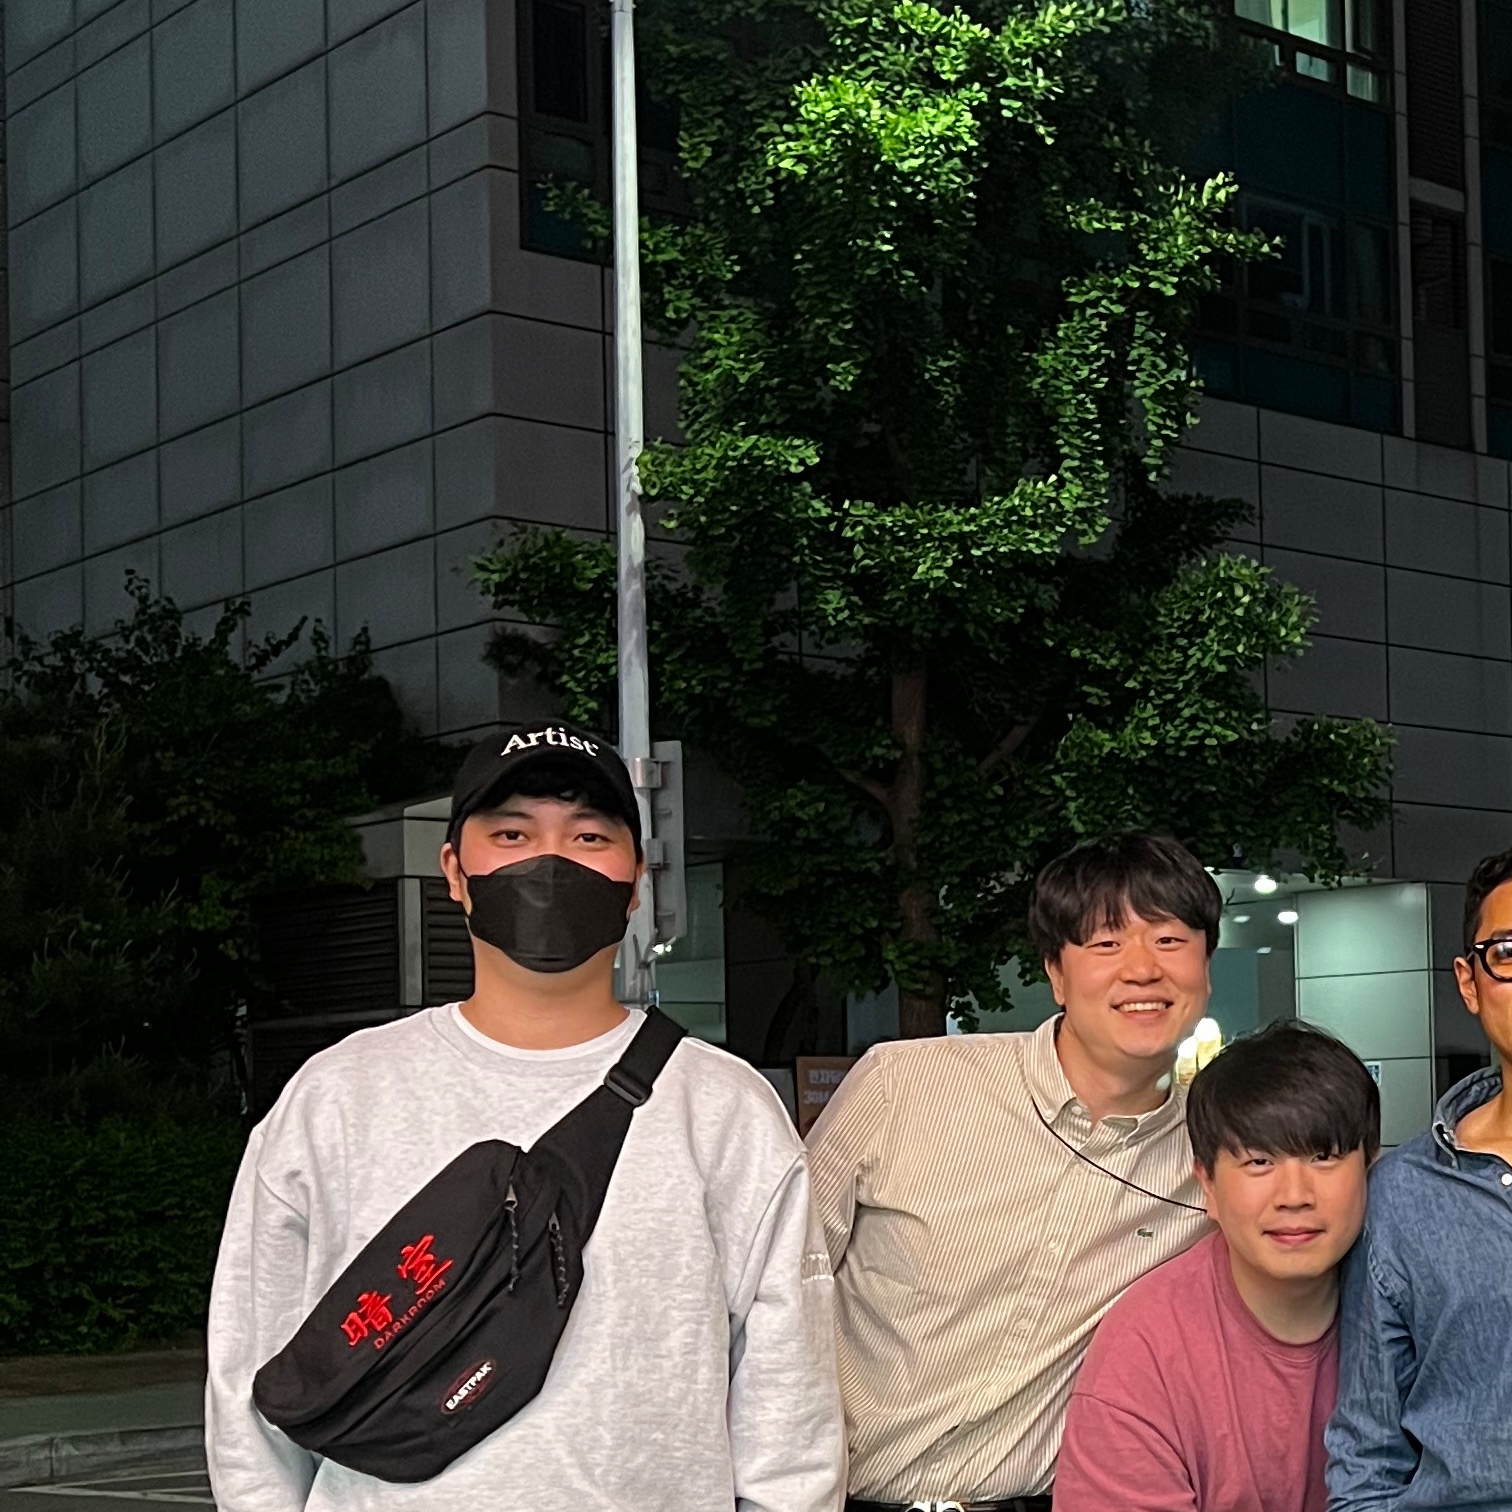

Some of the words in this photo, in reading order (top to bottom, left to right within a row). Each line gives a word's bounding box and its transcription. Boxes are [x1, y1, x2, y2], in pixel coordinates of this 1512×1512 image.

[500, 727, 599, 757] Artist
[373, 1278, 447, 1350] DARKROOM
[446, 1361, 493, 1411] EASTPAK
